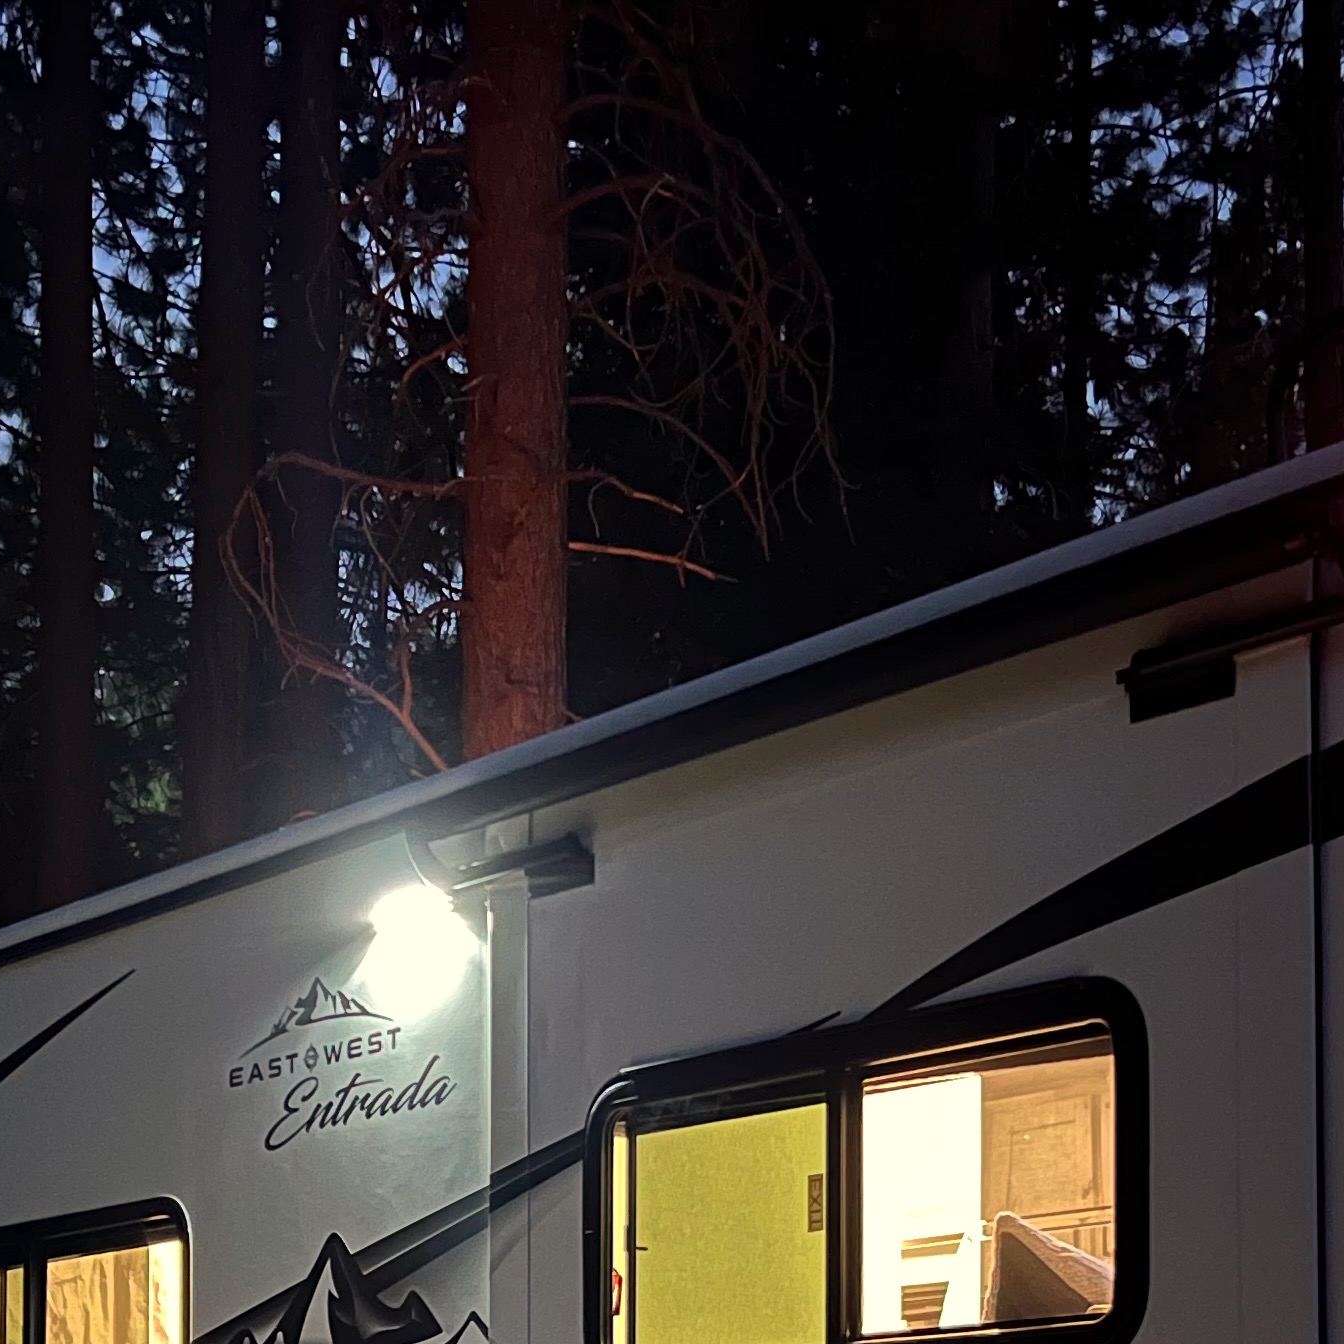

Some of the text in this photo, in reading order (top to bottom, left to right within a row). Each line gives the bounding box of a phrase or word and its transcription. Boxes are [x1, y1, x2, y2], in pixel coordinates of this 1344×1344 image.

[228, 1026, 402, 1089] EAST WEST
[263, 1054, 458, 1152] Entrada
